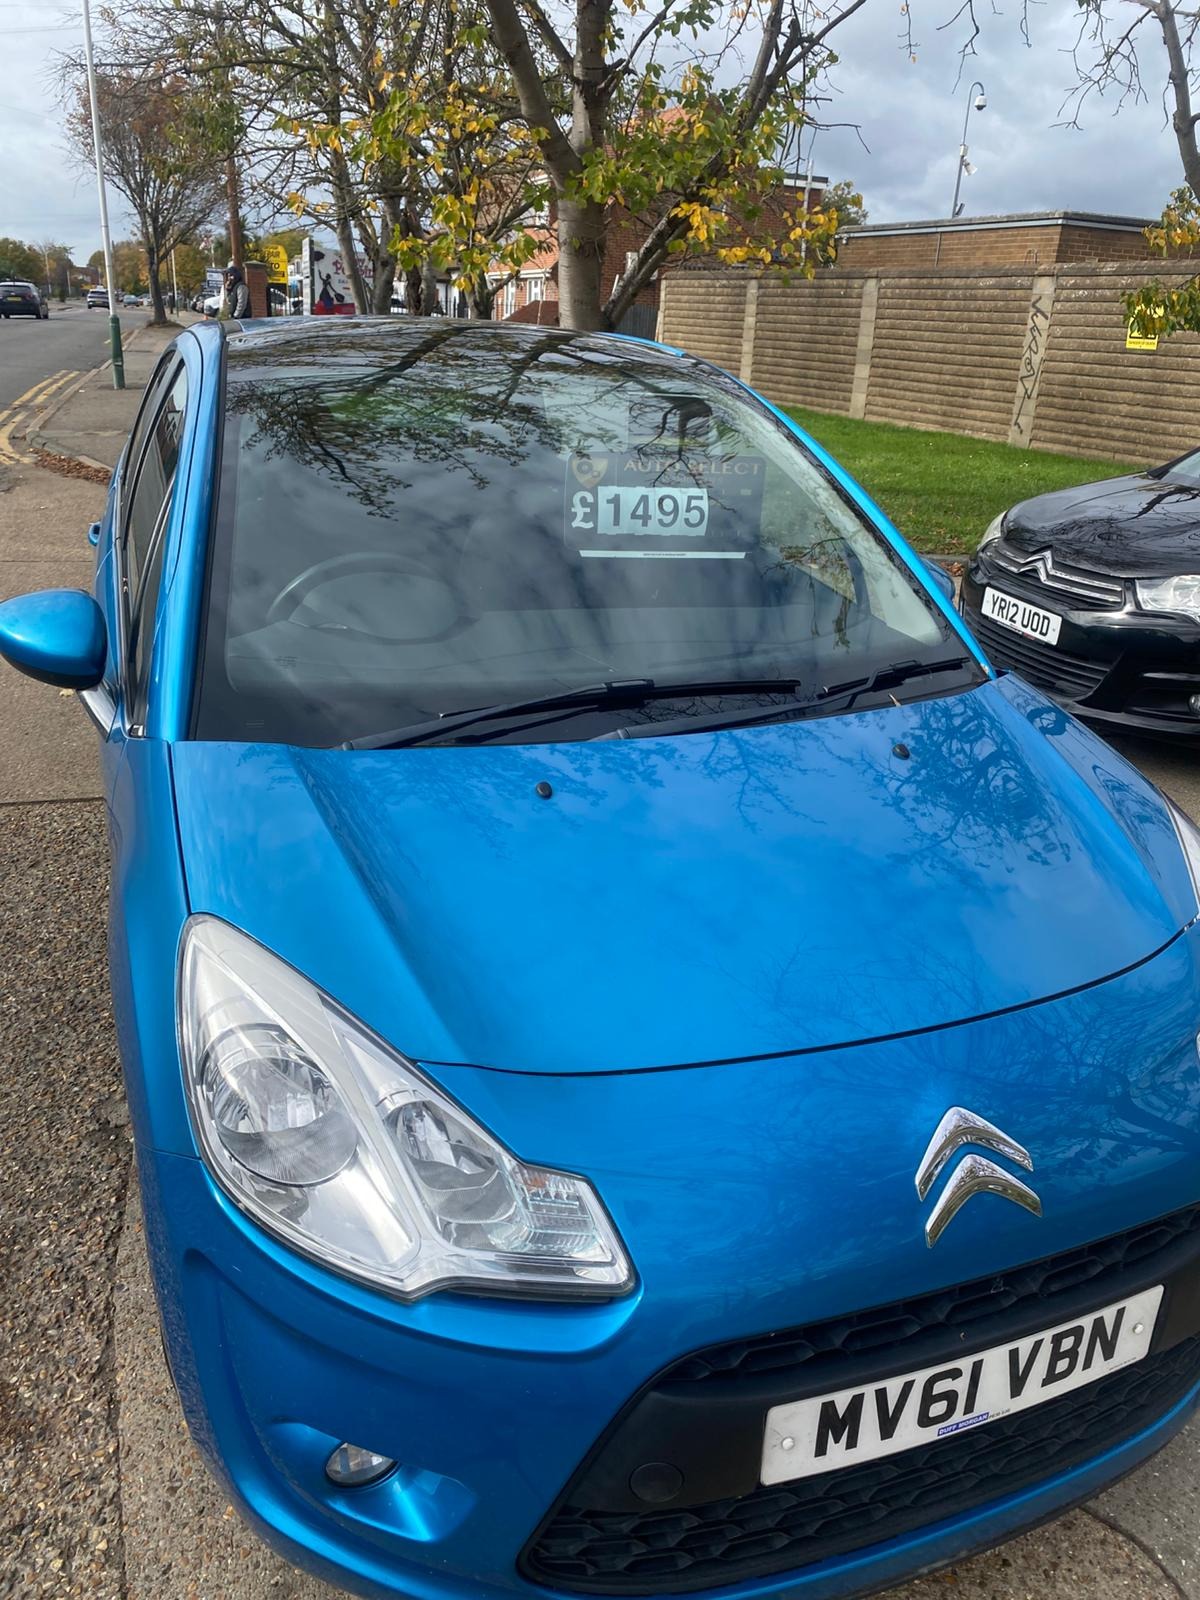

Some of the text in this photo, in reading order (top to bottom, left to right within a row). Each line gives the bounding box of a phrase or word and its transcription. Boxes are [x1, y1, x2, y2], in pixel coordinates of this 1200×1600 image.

[623, 459, 681, 473] AUTO
[991, 593, 1051, 637] YR12 UOD
[813, 1306, 1126, 1458] MV61 VBN
[938, 1424, 958, 1435] DUFF
[958, 1413, 988, 1429] MORGAN
